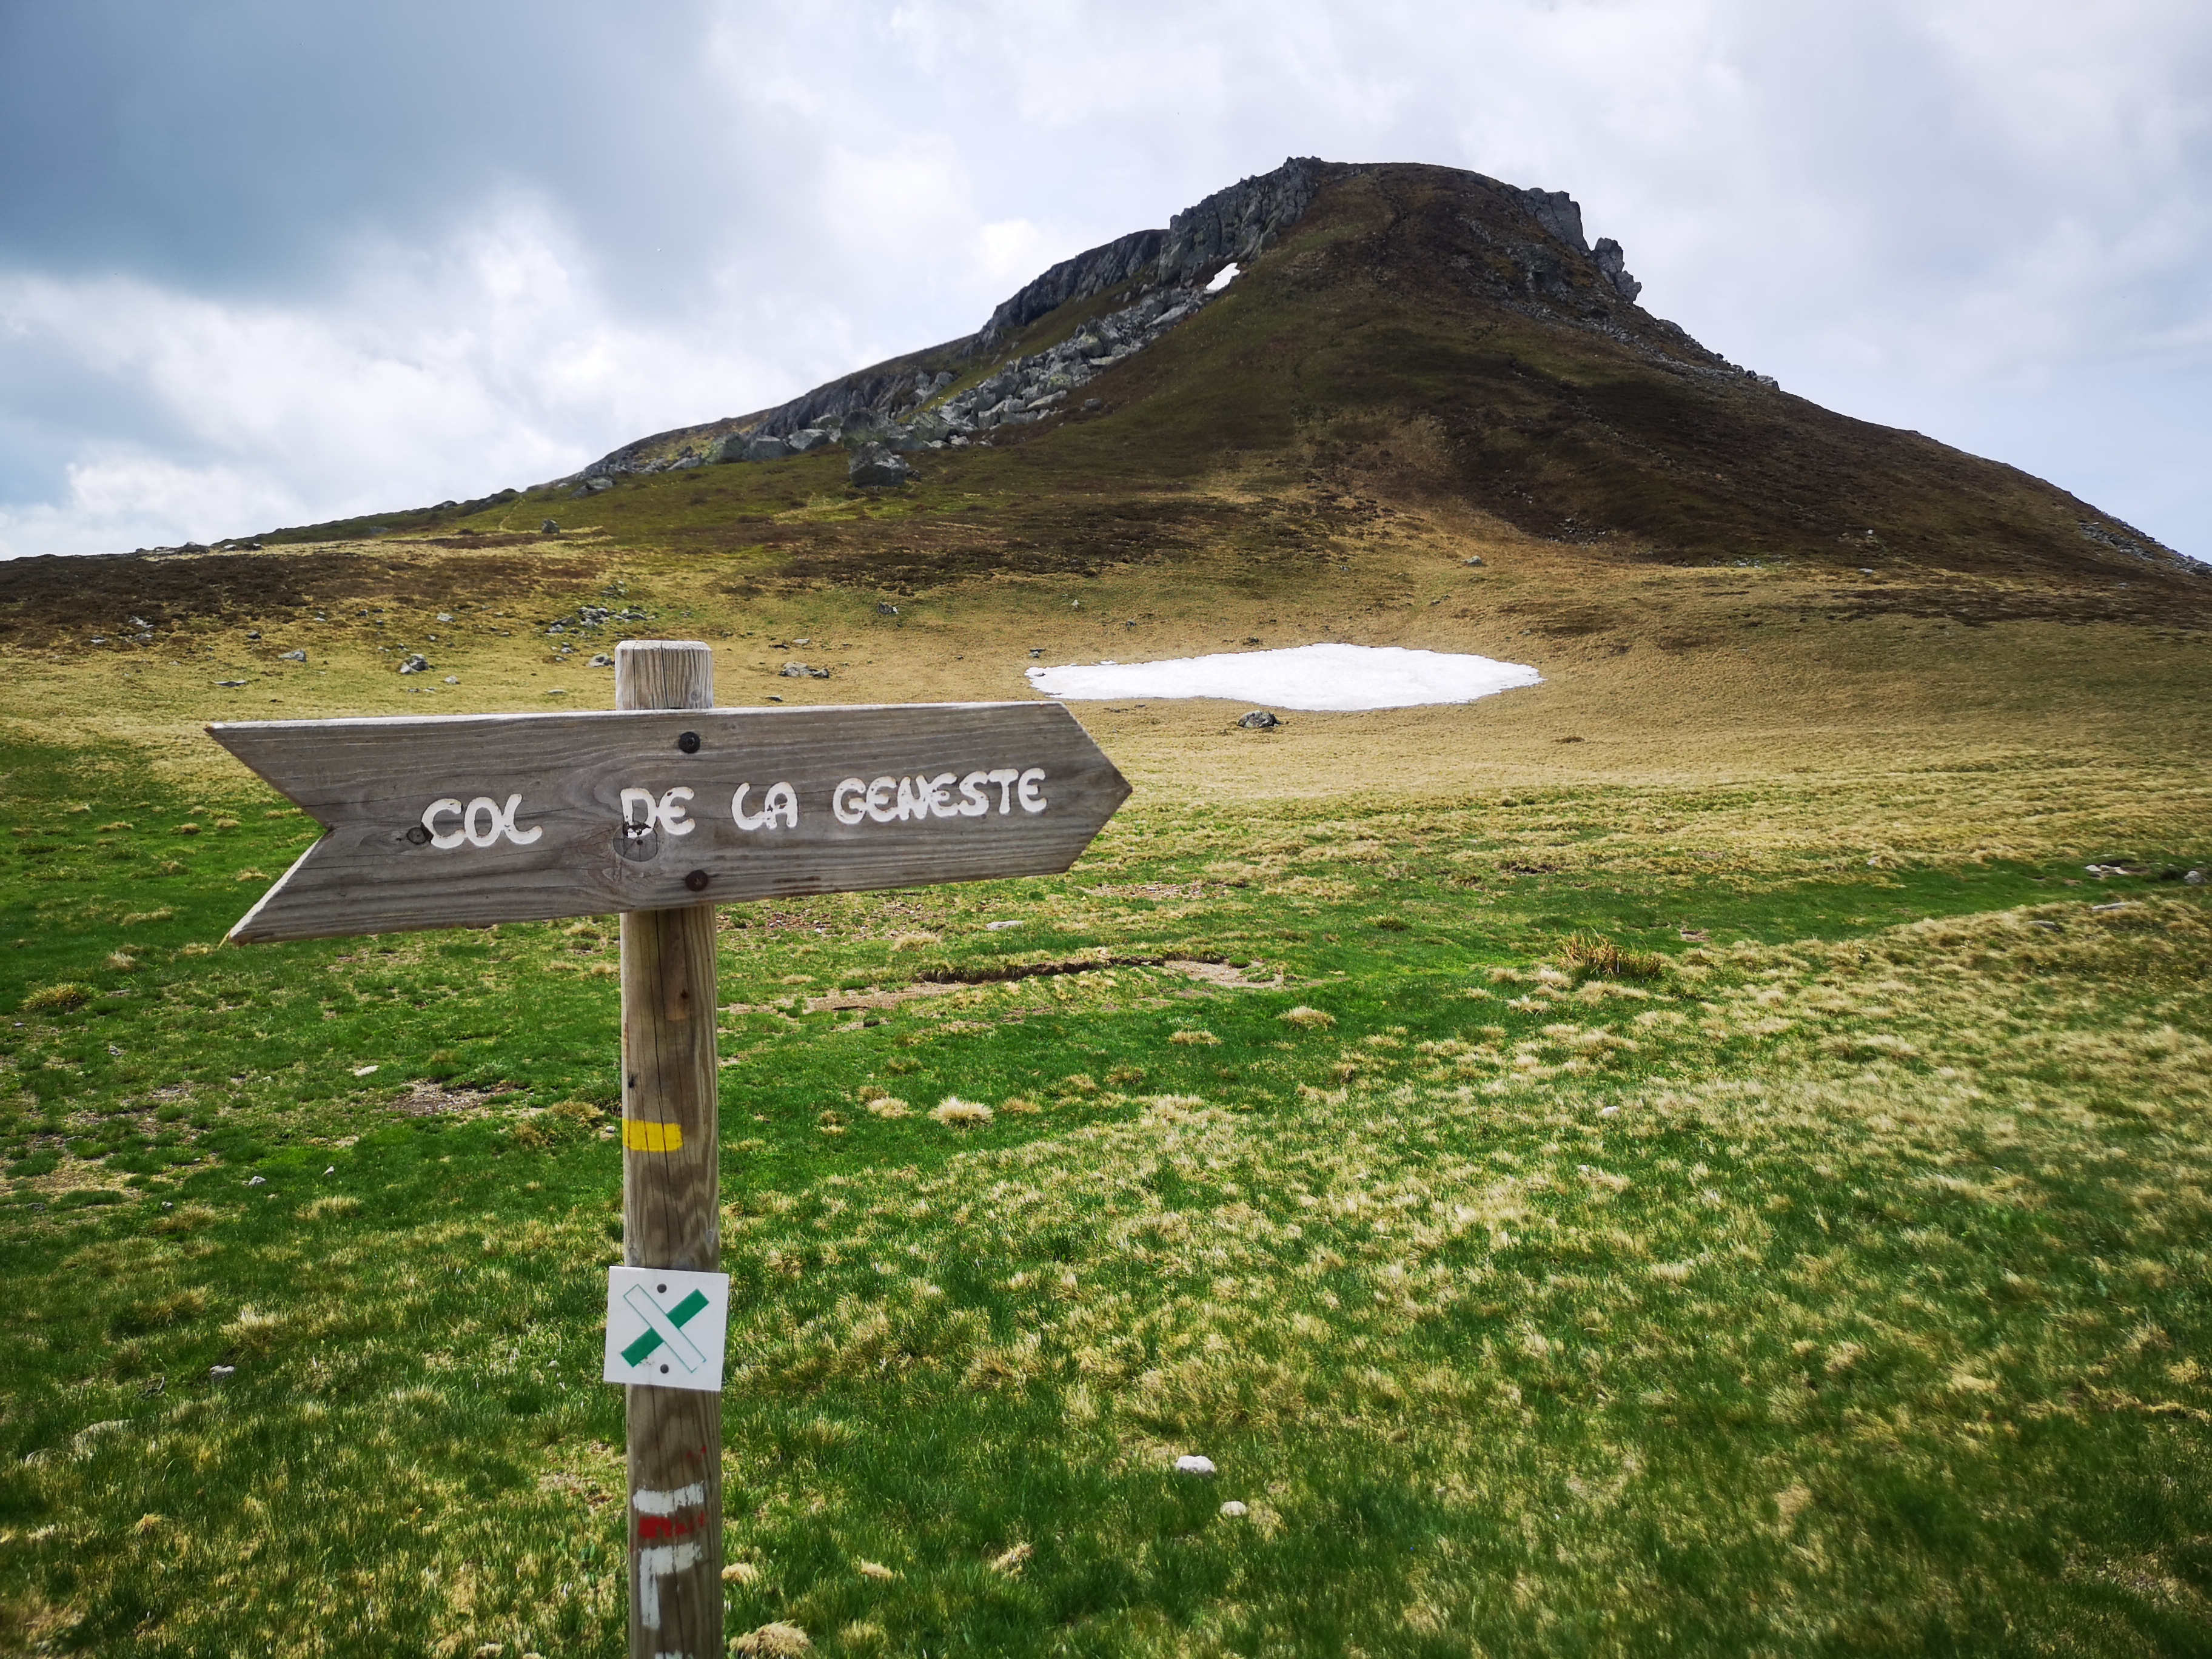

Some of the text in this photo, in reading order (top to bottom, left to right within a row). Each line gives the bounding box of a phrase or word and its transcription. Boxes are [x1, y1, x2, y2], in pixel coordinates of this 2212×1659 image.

[421, 767, 1048, 849] COL DE LA GENESTE
